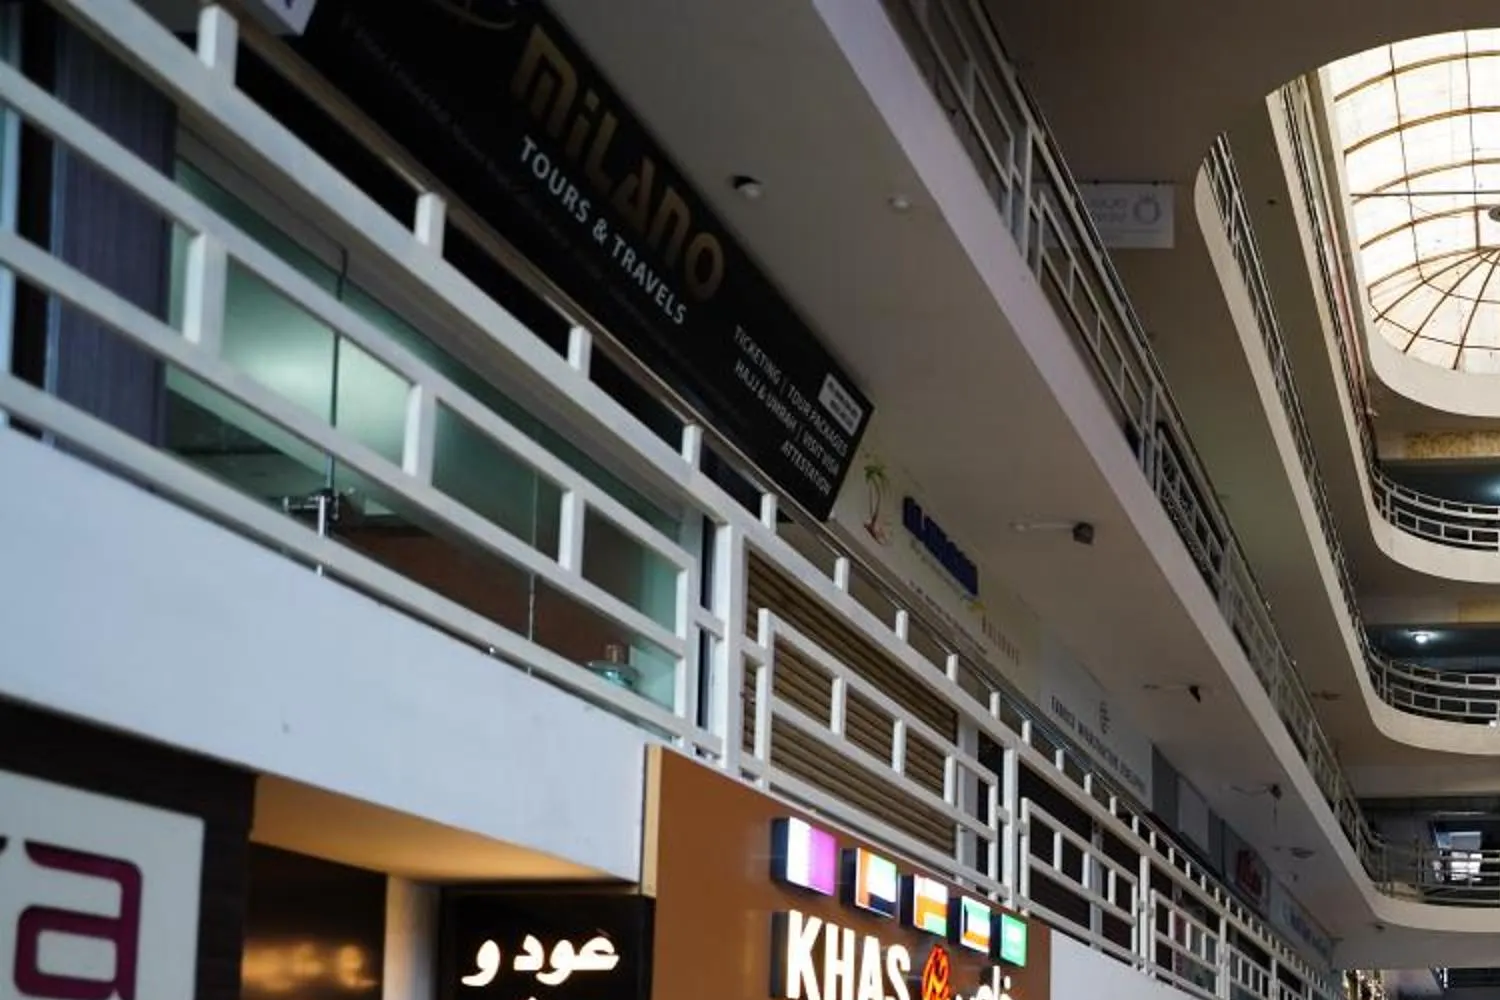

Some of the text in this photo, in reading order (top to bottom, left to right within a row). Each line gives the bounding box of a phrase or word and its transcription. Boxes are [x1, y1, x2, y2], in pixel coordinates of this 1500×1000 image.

[520, 135, 688, 325] TOURS & TRAVELS
[735, 324, 782, 385] TICKETING
[787, 383, 812, 416] TOUR
[735, 359, 761, 392] HAJJ
[460, 933, 620, 988] عود و
